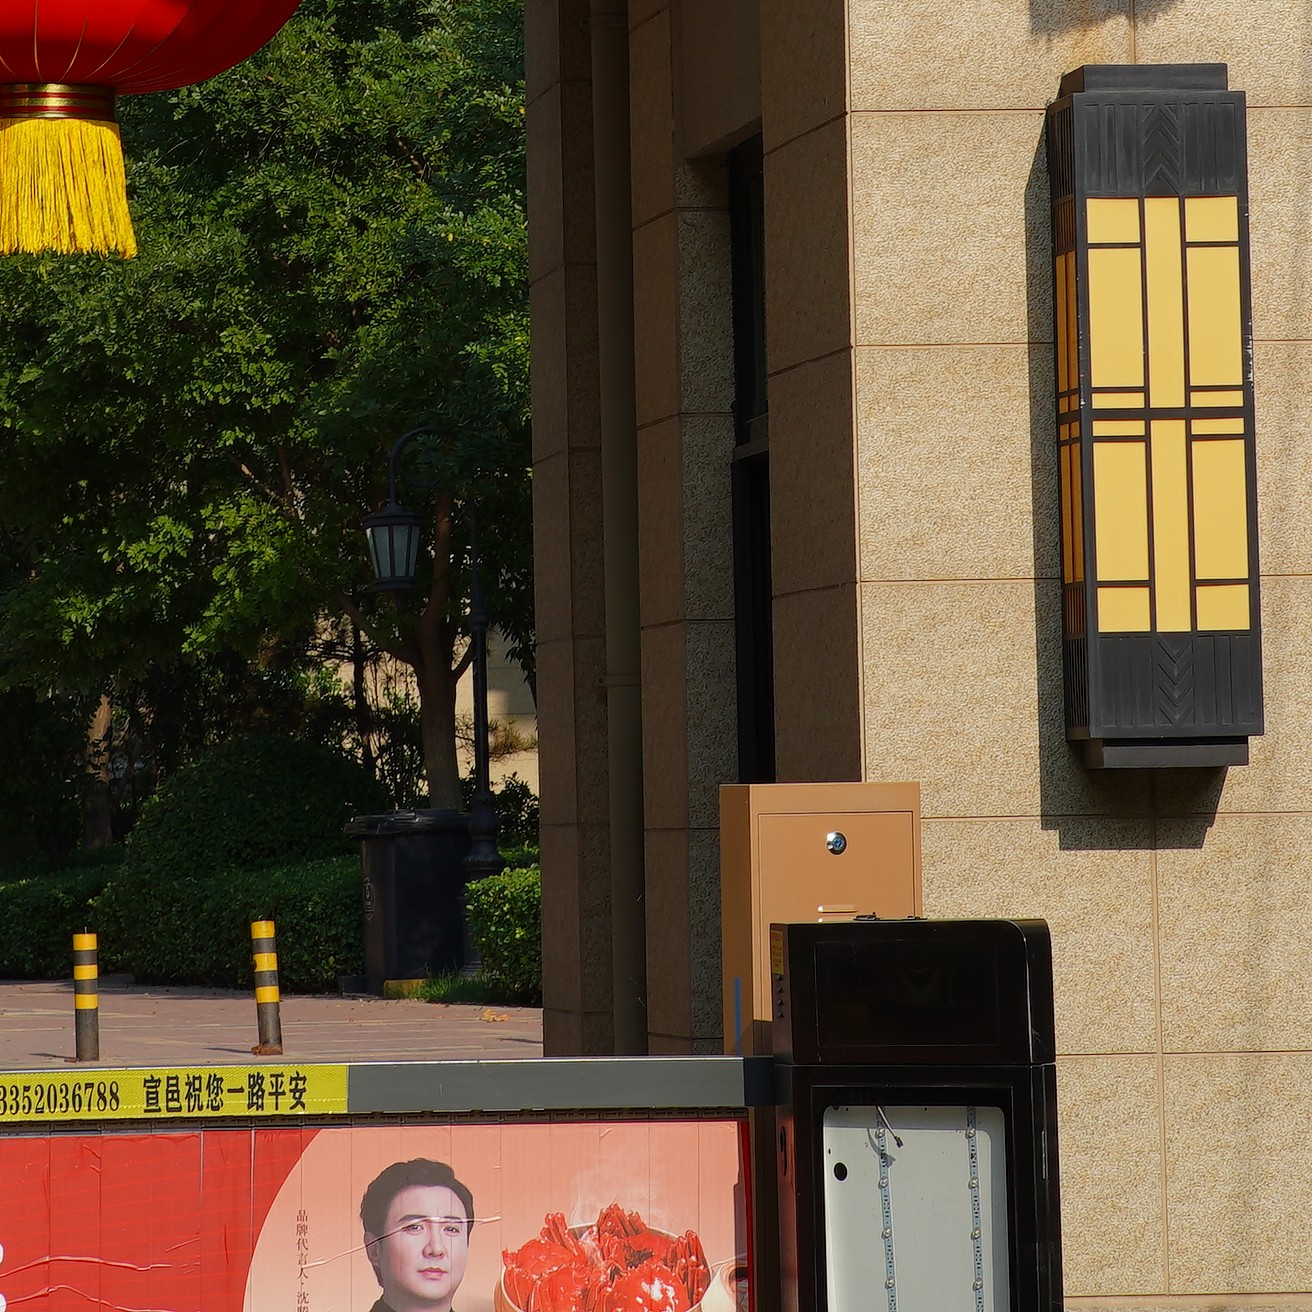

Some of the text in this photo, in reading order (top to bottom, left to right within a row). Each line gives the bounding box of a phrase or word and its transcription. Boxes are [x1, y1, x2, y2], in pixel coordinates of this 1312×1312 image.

[142, 1070, 308, 1114] 宣邑祝您一路平安
